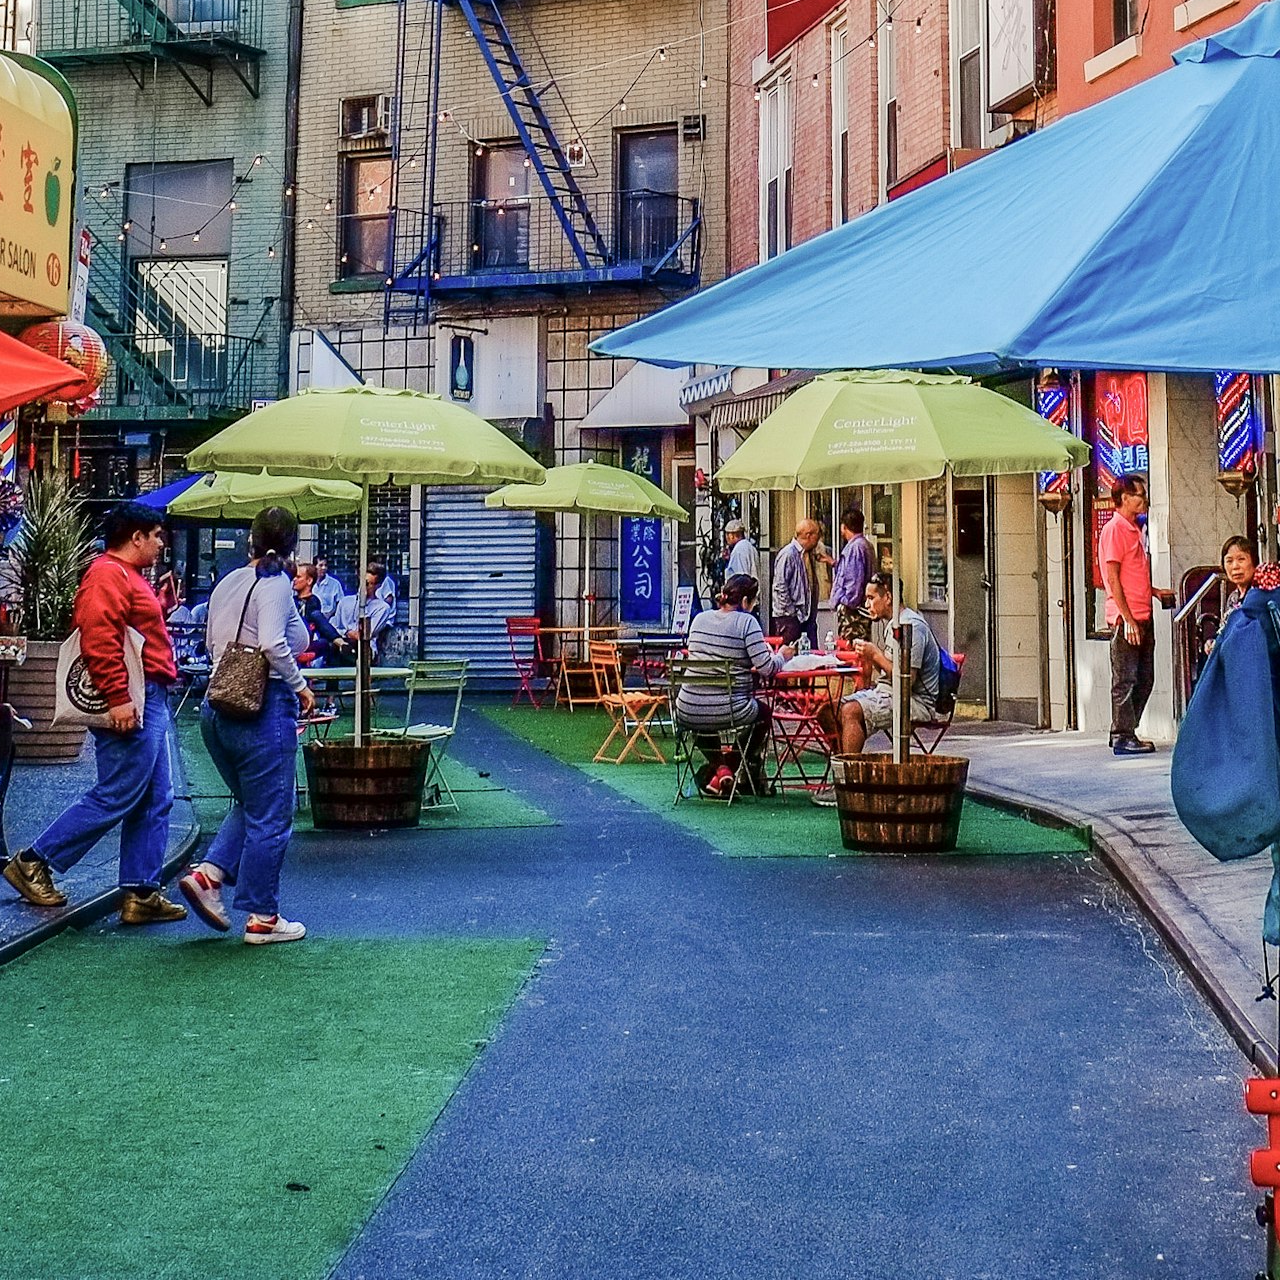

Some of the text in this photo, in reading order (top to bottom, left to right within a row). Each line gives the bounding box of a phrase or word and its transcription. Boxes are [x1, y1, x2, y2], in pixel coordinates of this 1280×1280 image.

[7, 239, 37, 280] SALON
[48, 254, 60, 286] 16
[360, 418, 437, 431] CenterLight
[834, 416, 917, 429] CenterLight
[632, 544, 653, 599] 公司
